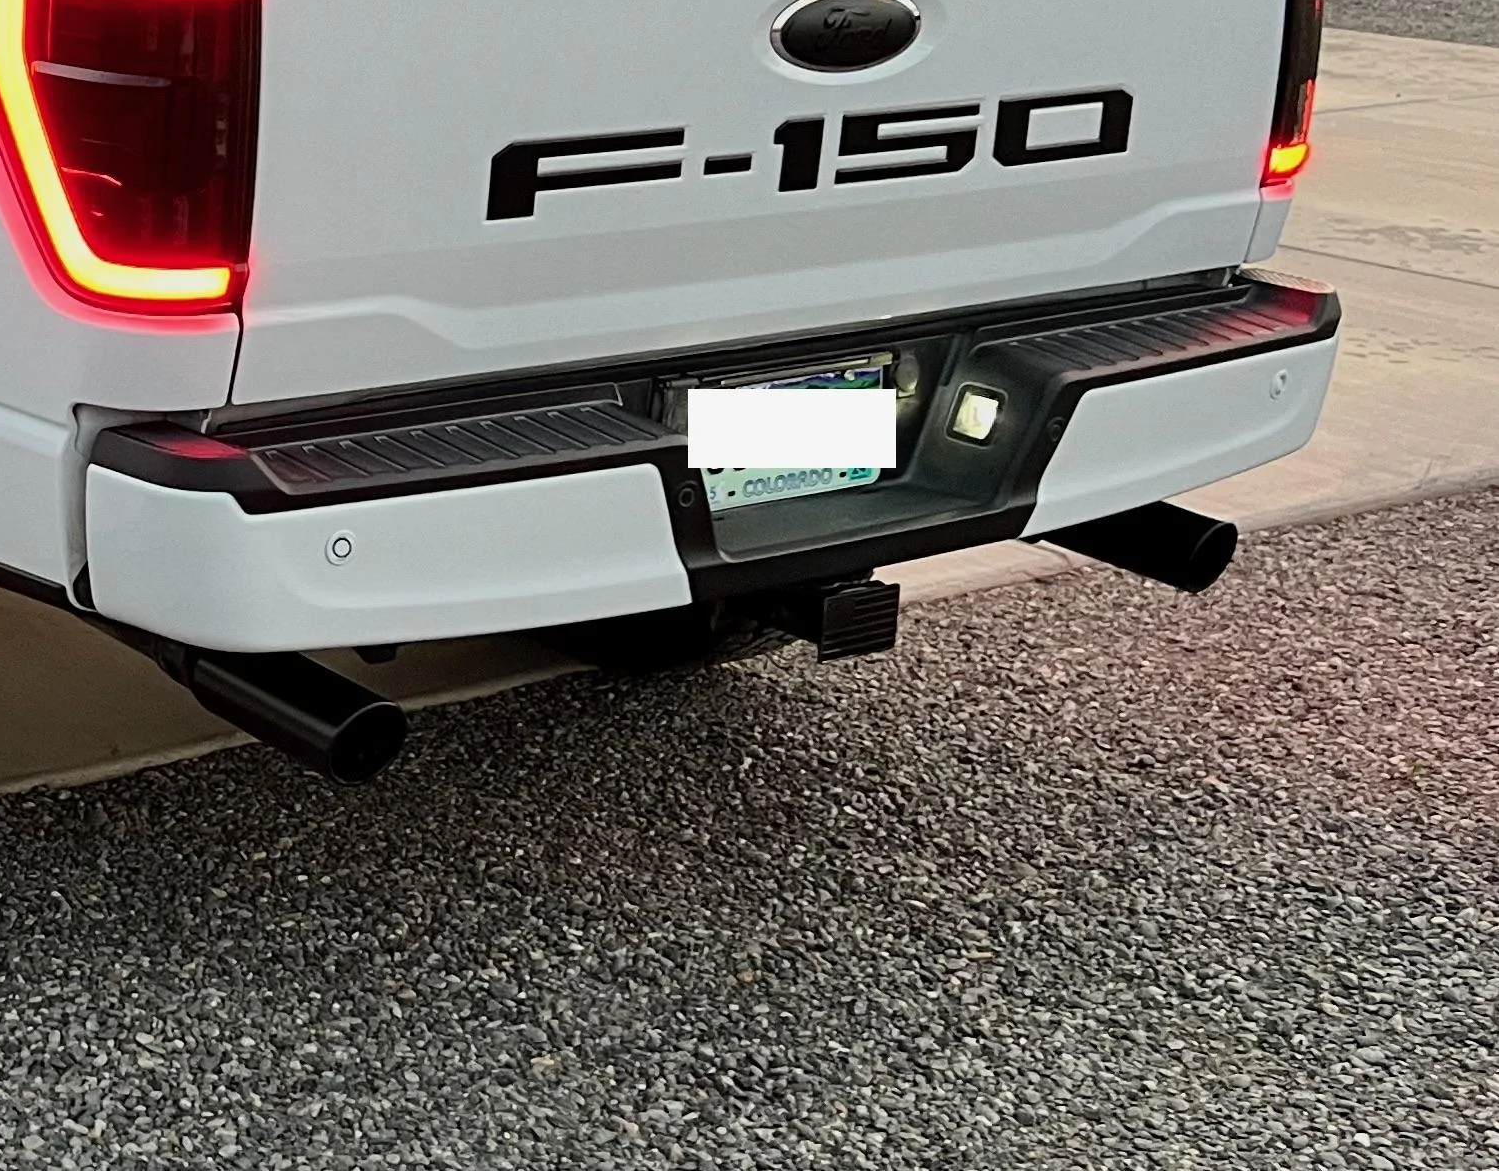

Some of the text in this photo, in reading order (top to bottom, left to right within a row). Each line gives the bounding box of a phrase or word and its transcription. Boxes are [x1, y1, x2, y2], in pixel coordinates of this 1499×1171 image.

[814, 6, 893, 50] Ford
[486, 88, 1134, 221] F-150
[742, 468, 833, 498] COLORADO
